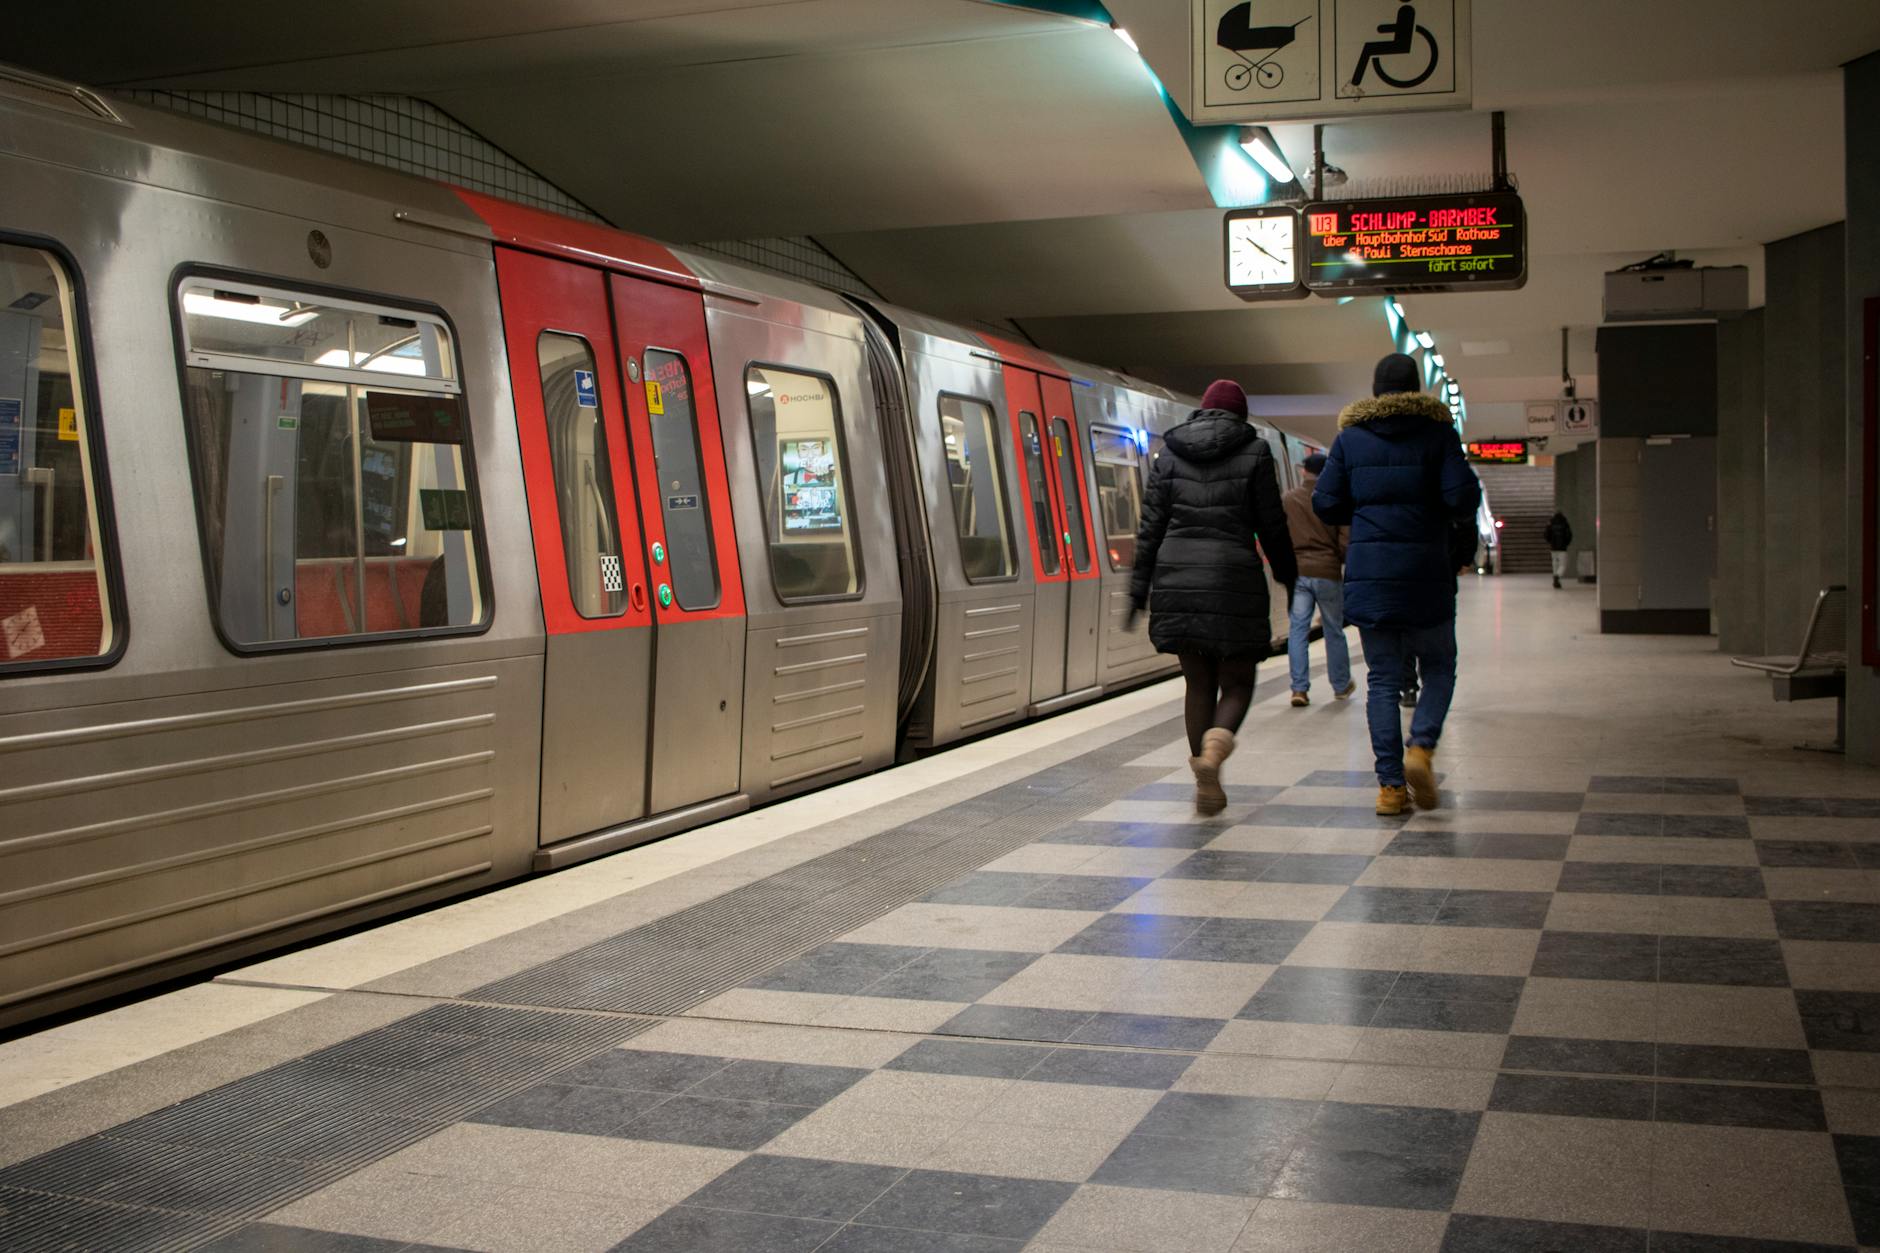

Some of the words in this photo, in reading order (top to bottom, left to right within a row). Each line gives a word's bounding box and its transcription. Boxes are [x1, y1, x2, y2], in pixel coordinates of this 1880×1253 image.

[1316, 216, 1331, 232] U3
[1351, 211, 1416, 231] SCHLUMP
[1429, 207, 1496, 228] BARMBEK
[1323, 234, 1347, 247] über
[1456, 228, 1499, 240] Rathaus
[1400, 243, 1471, 257] Sternschanze
[1460, 257, 1494, 271] sofort
